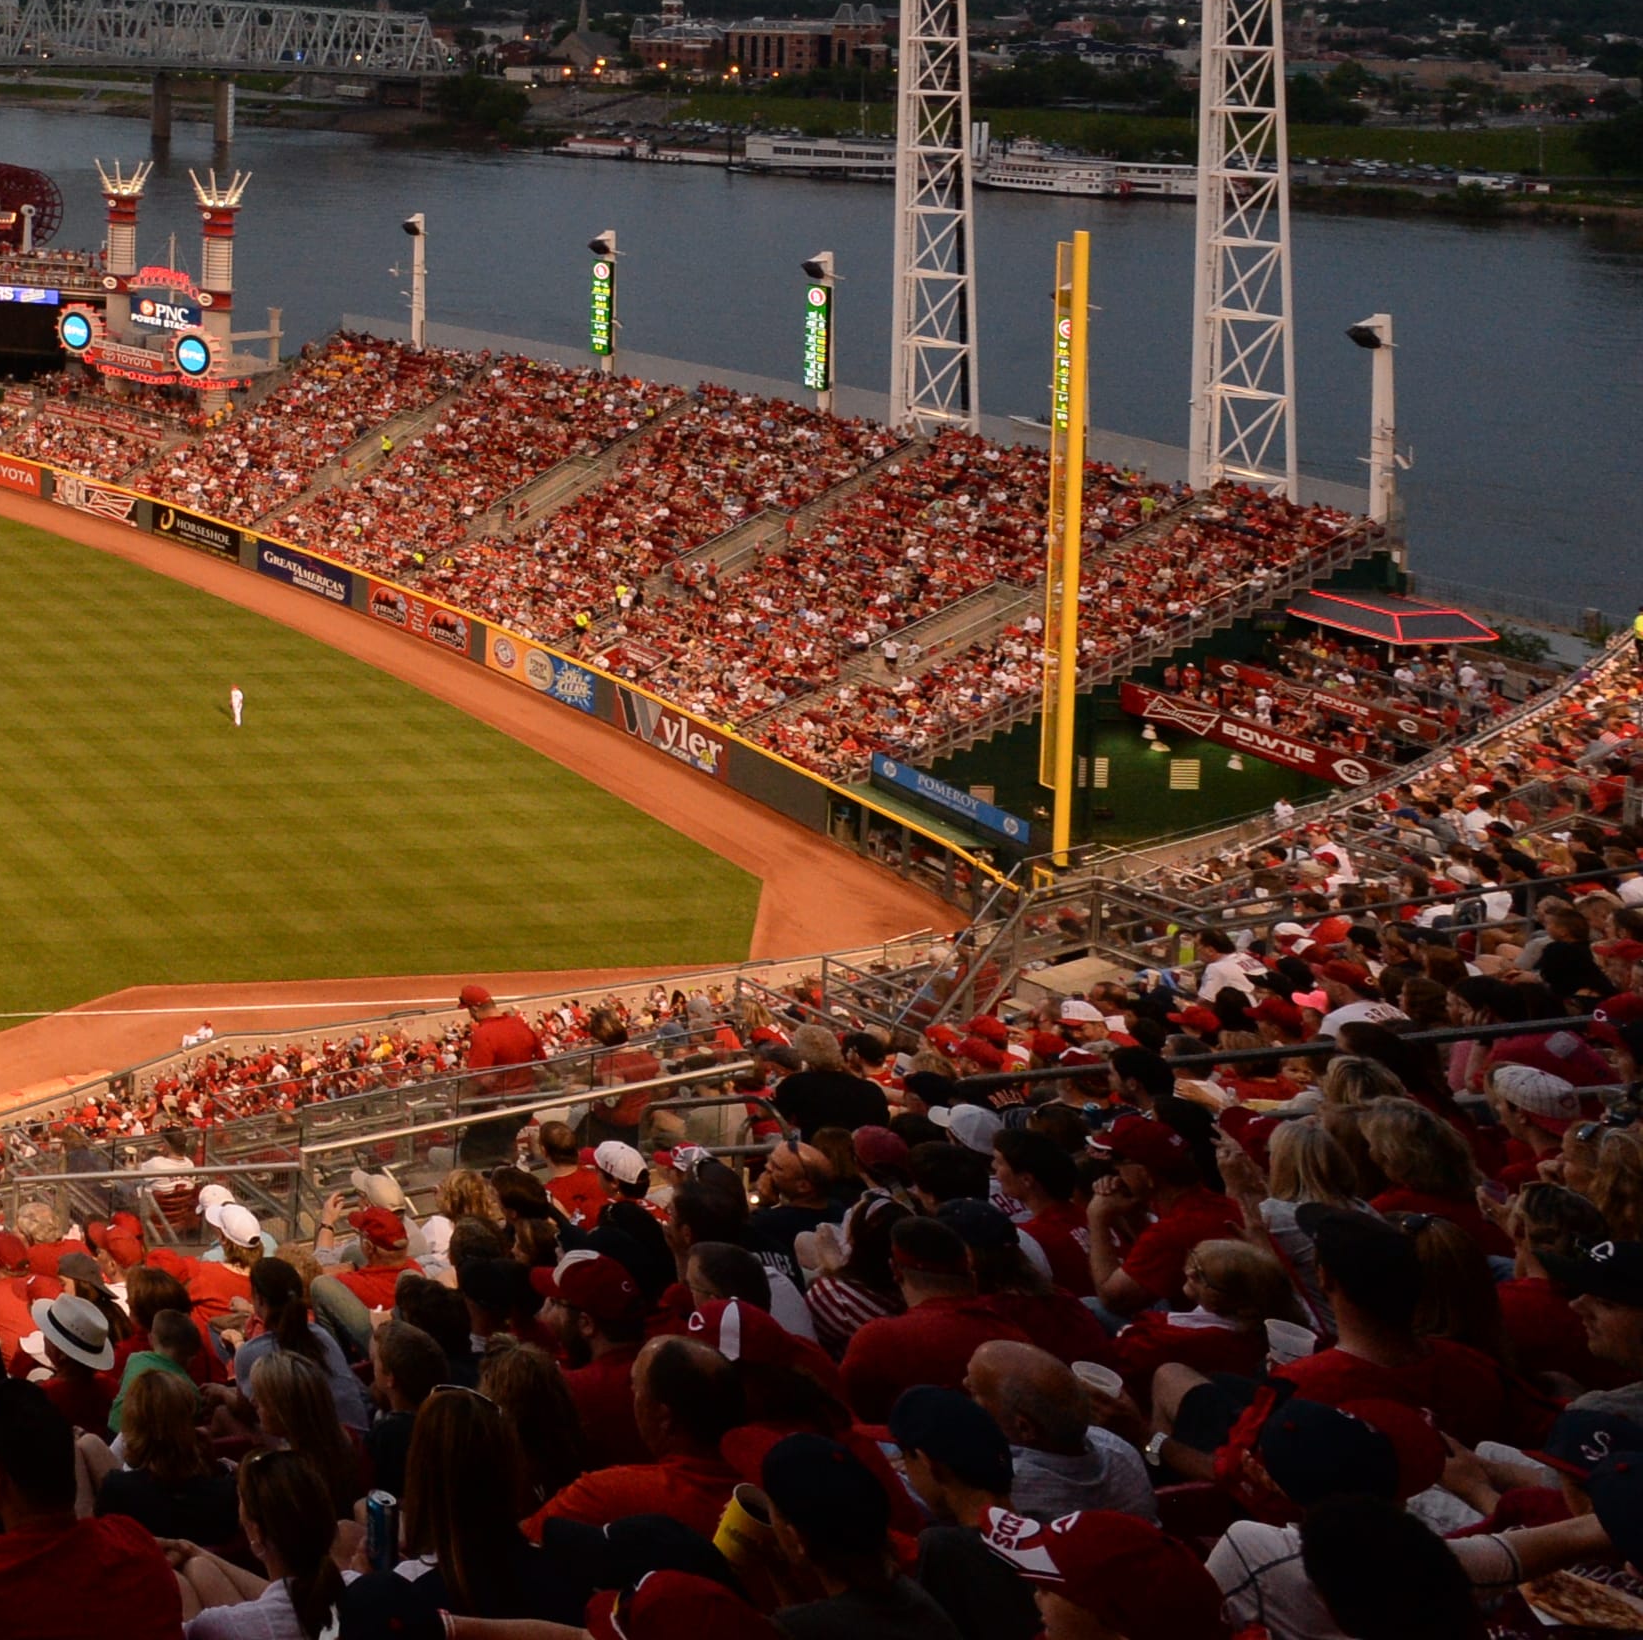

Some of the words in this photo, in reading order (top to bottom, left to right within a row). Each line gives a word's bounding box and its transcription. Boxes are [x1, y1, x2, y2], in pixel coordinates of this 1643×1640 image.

[131, 313, 162, 327] POWER
[155, 303, 190, 323] PNC
[116, 354, 154, 370] TOYOTA
[176, 517, 232, 547] HORSESHOE
[263, 550, 298, 575] GREAT
[292, 564, 347, 594] AMERICAN
[292, 575, 325, 595] INSURANCE
[325, 586, 346, 602] GROUP
[1313, 691, 1370, 717] BOWTIE
[616, 684, 723, 766] Wyler
[1221, 721, 1317, 762] BOWTIE
[917, 773, 981, 811] POMEROY
